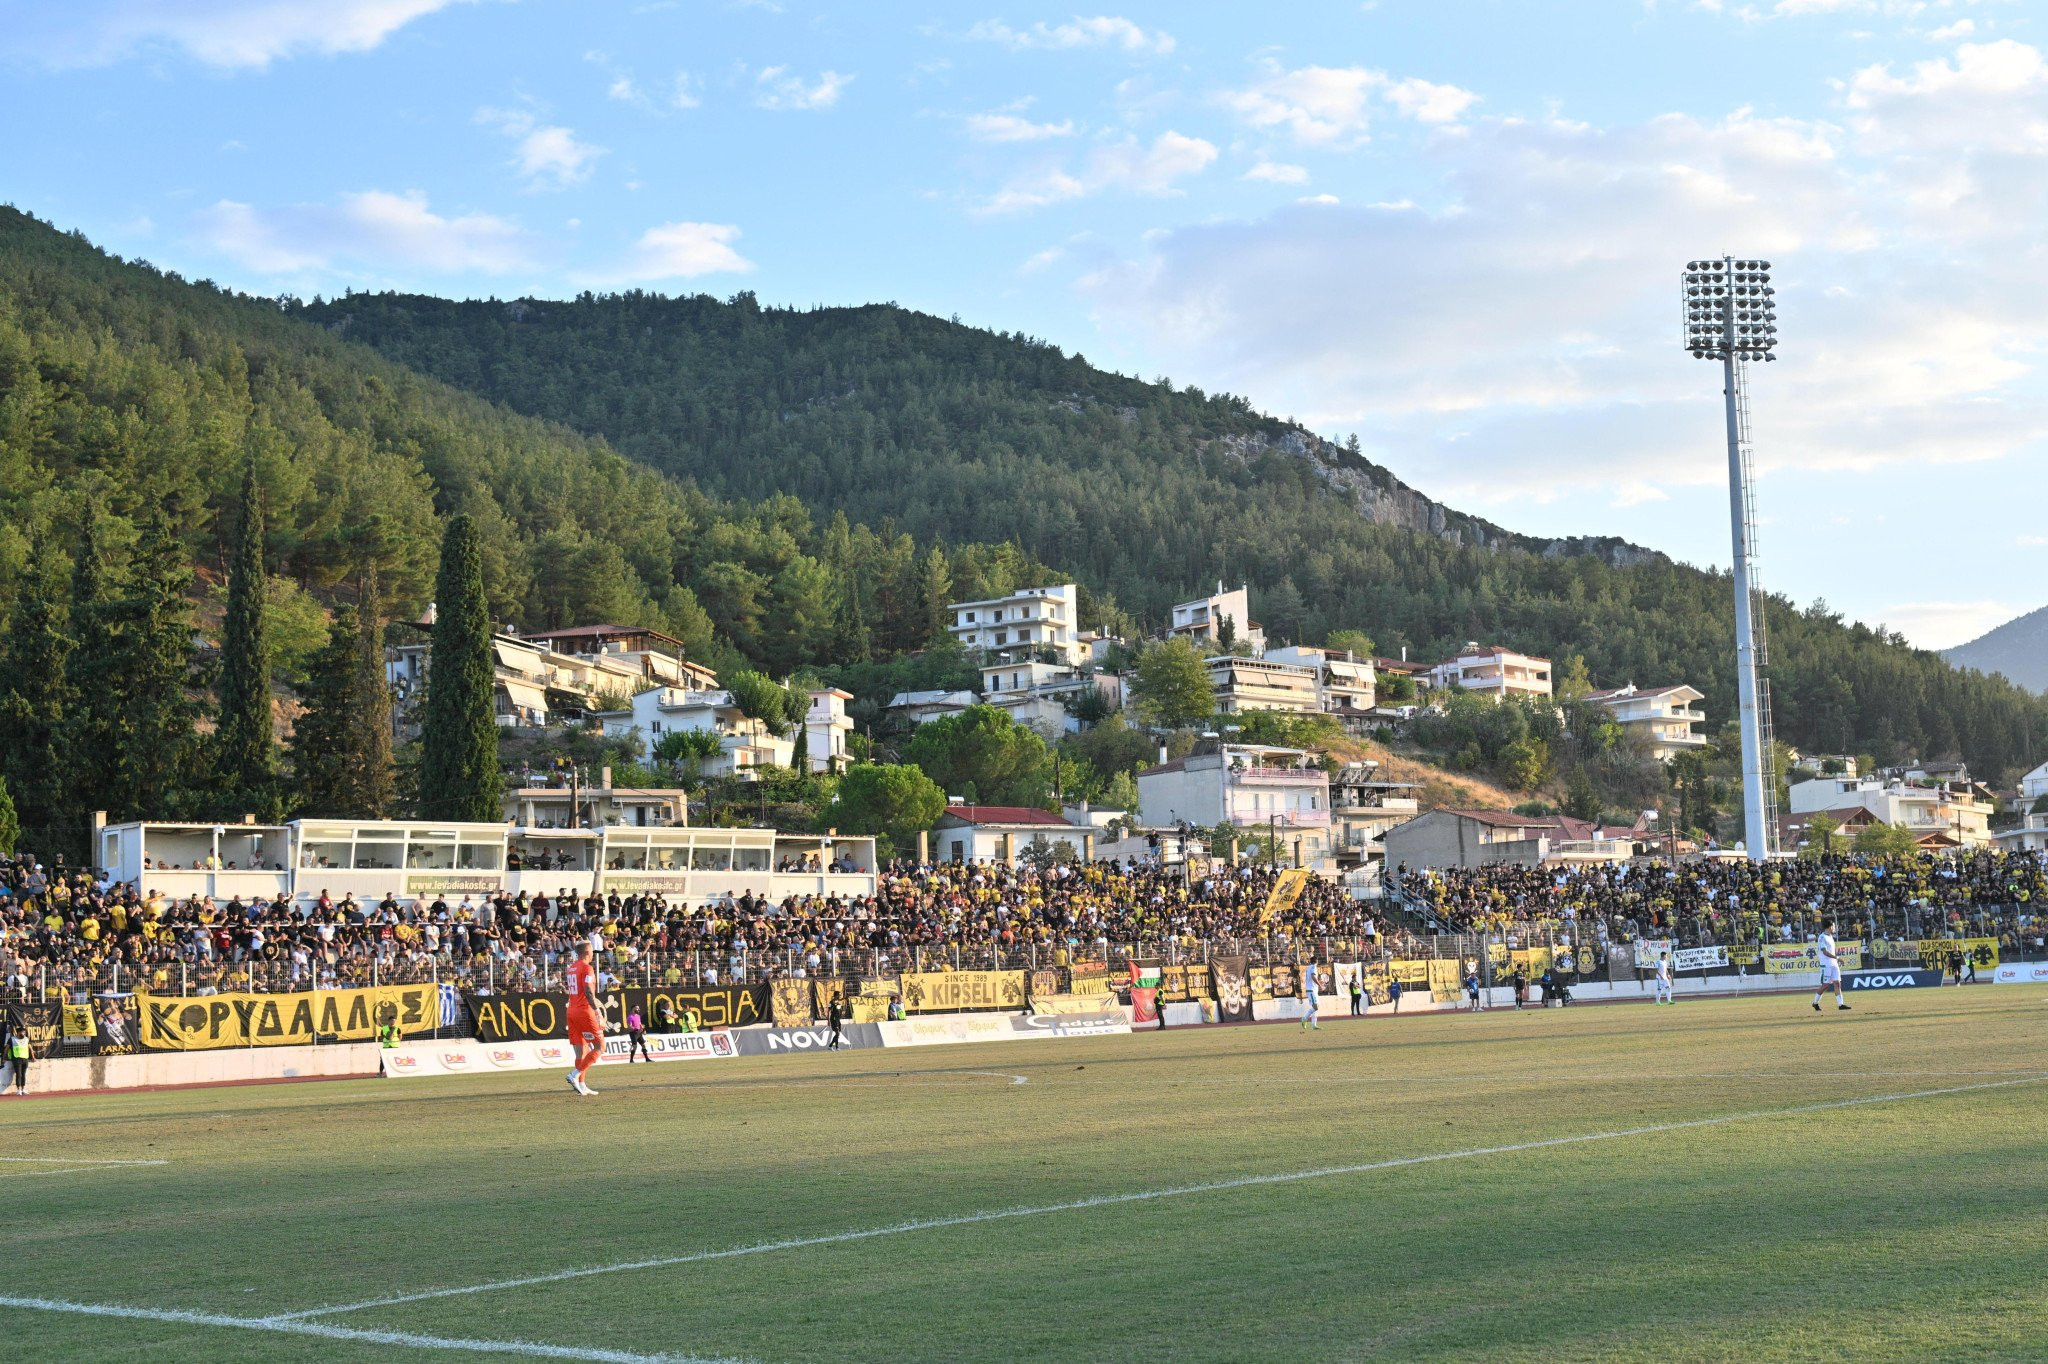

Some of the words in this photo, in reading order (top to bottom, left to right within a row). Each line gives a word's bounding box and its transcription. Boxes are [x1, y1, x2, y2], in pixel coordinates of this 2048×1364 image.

[410, 880, 498, 891] www.levadiakosfc.gr
[771, 978, 811, 990] YELLOW
[945, 975, 969, 983] SINCE
[1853, 974, 1916, 988] NOVA
[150, 990, 423, 1041] ΚΟΡΥΔΑΛΛΟΣ
[475, 998, 556, 1037] ANO
[668, 1036, 706, 1050] ΨΗΤΟ
[767, 1030, 851, 1049] NOVA
[394, 1056, 417, 1065] Dole
[445, 1053, 466, 1063] Dole
[494, 1050, 515, 1060] Dole
[541, 1048, 561, 1057] Dole
